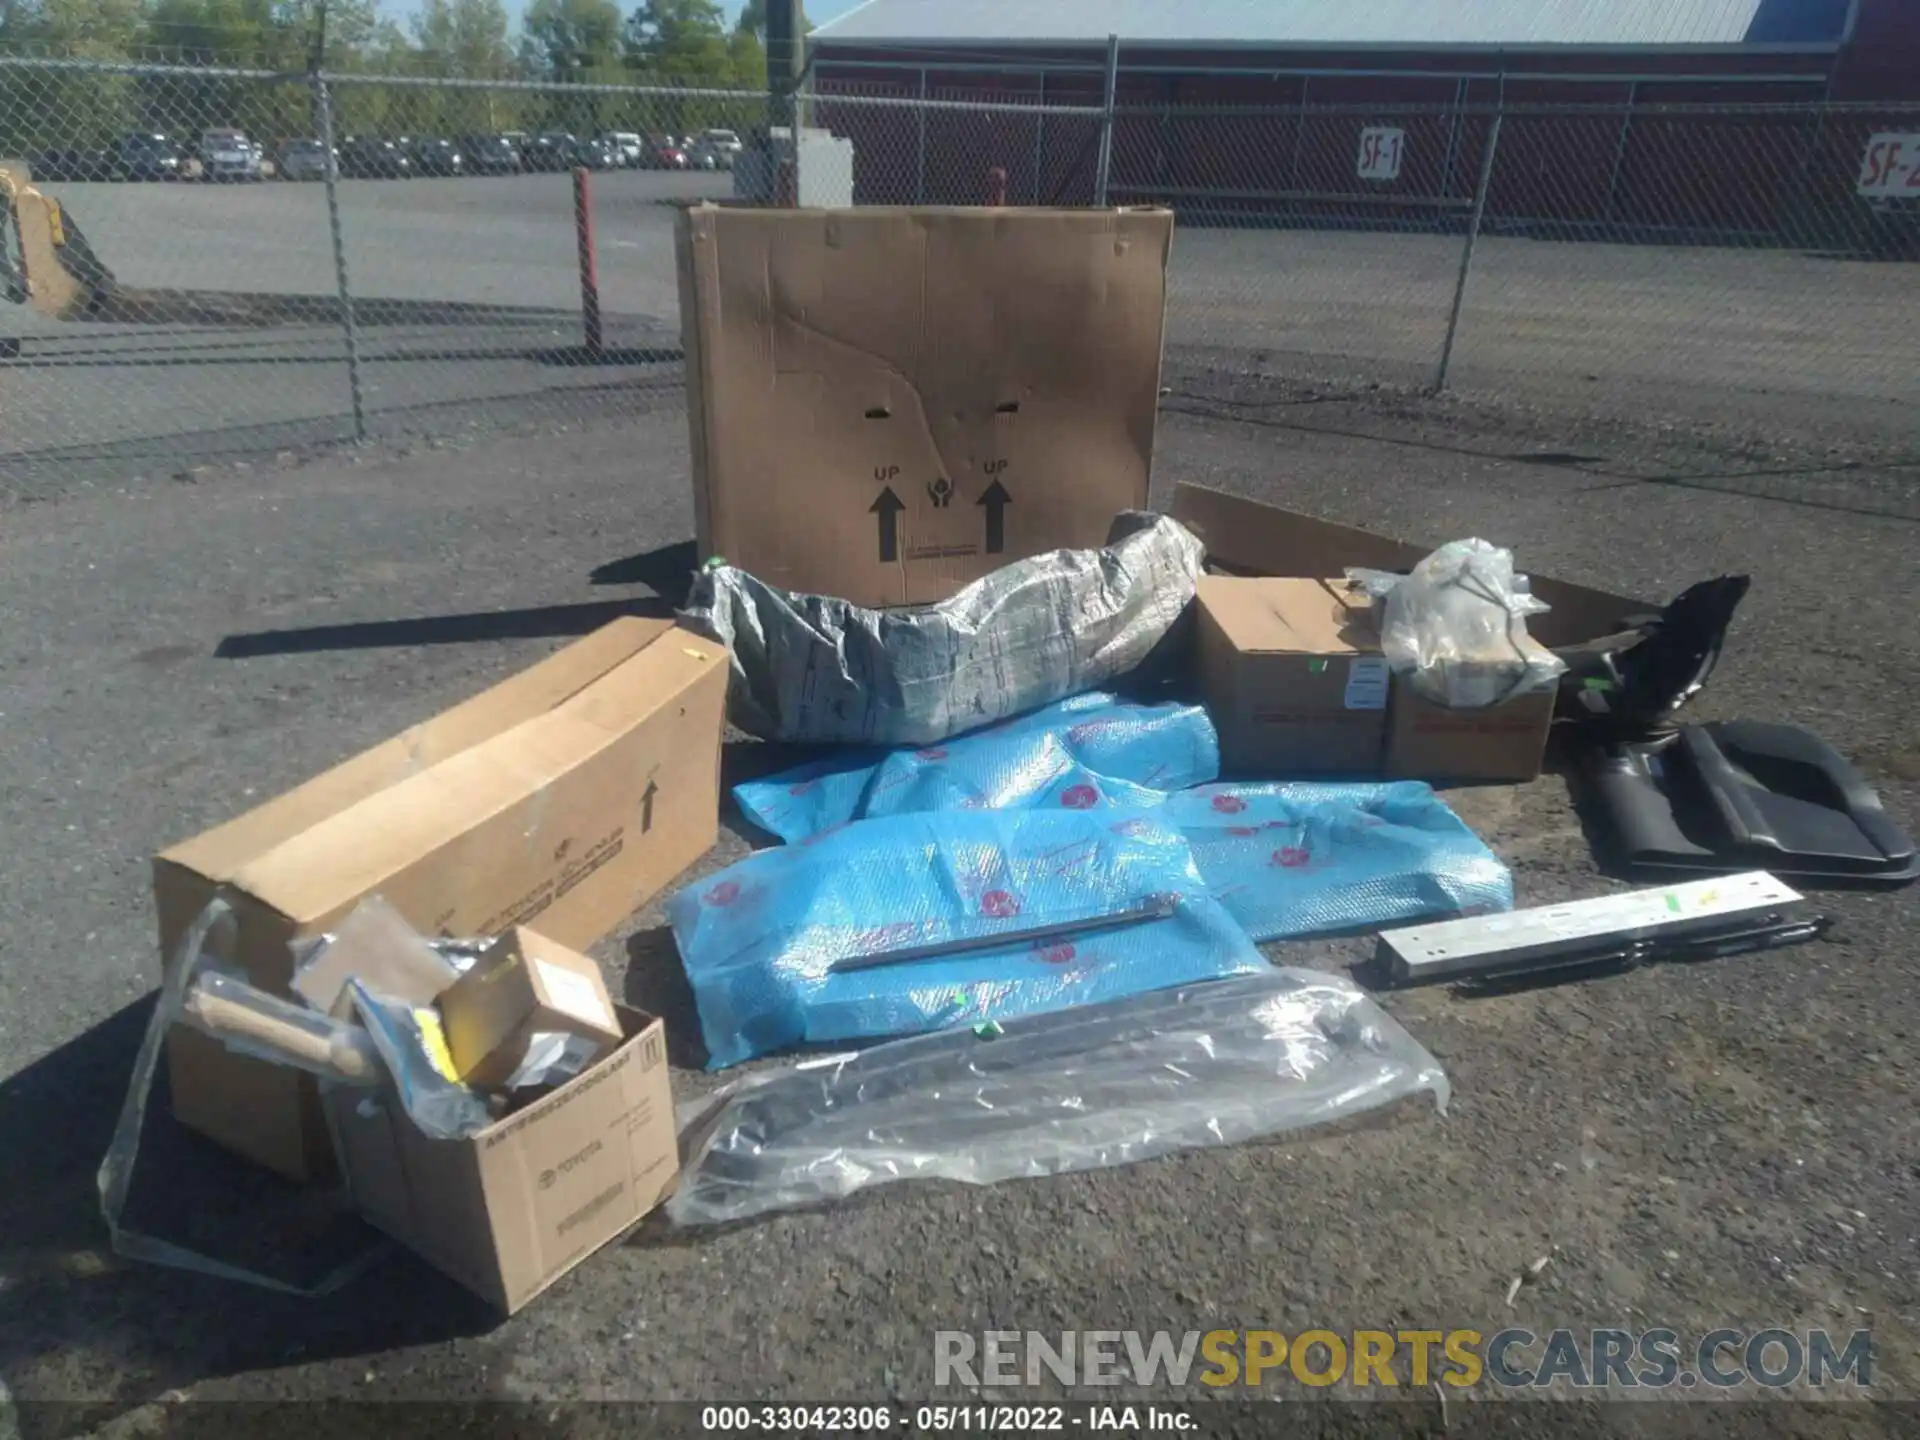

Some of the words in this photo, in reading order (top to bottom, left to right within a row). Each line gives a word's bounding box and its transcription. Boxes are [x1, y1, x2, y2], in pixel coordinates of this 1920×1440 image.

[1361, 135, 1398, 170] SF-1
[875, 465, 900, 481] UP
[984, 459, 1008, 474] UP
